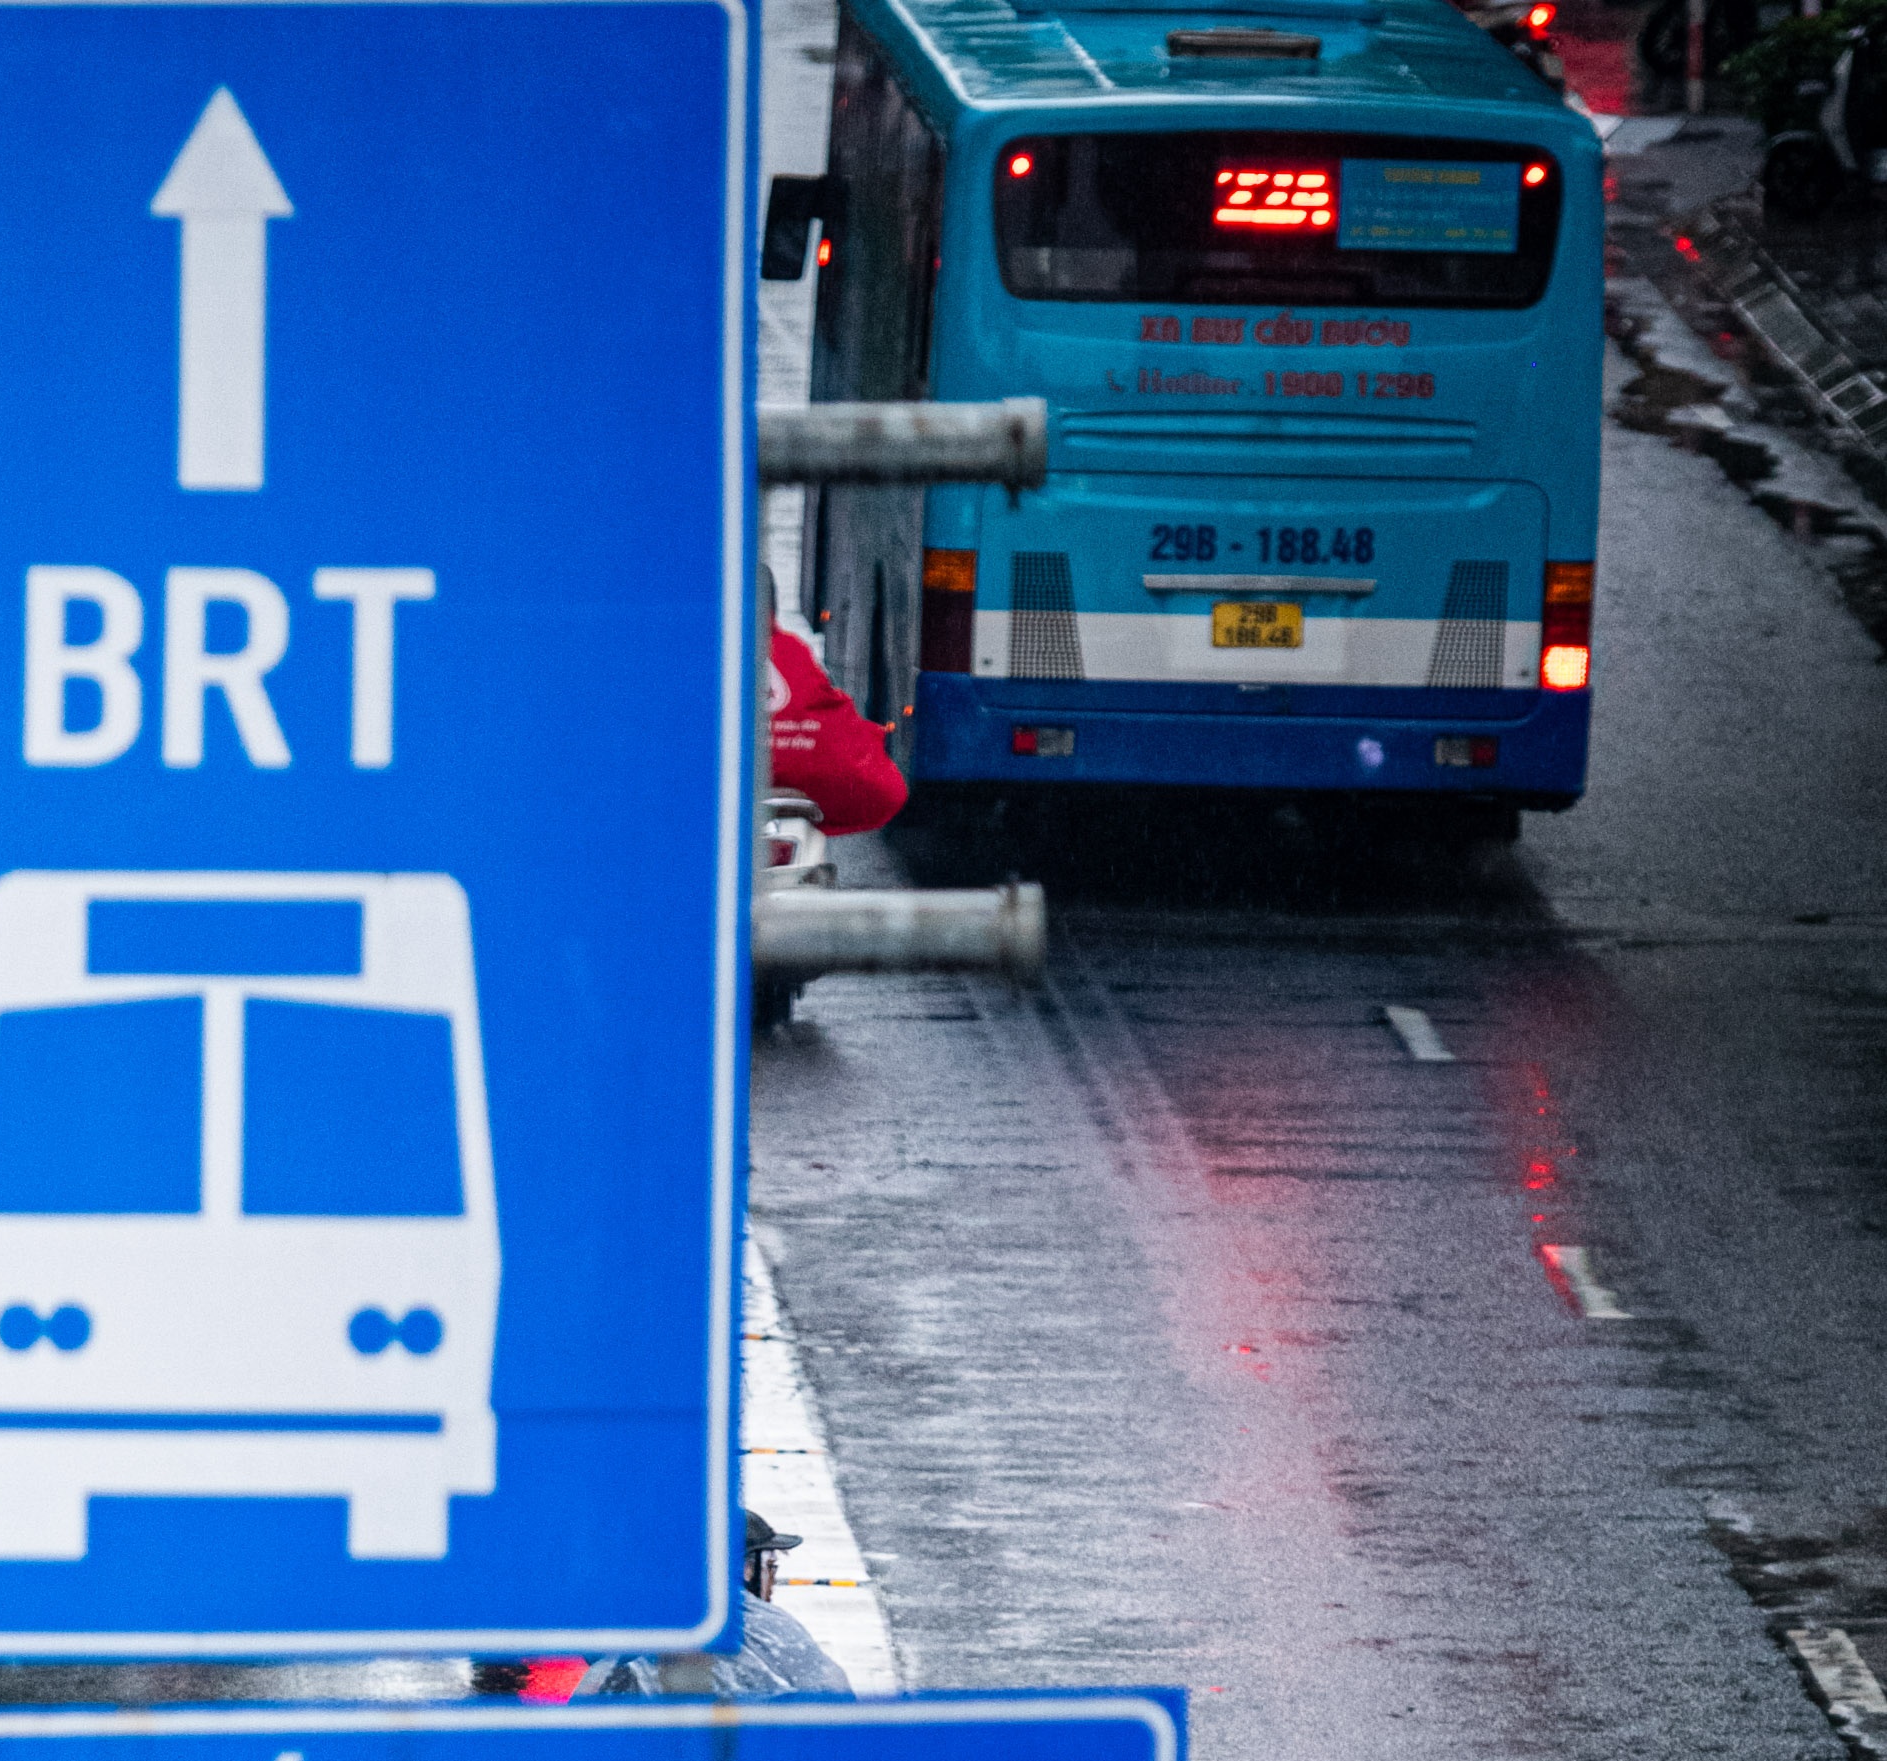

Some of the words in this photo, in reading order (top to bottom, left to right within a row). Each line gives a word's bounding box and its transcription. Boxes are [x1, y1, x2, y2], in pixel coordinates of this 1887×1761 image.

[1151, 523, 1218, 562] 29B
[1257, 526, 1376, 564] 188.48
[23, 564, 437, 769] BRT
